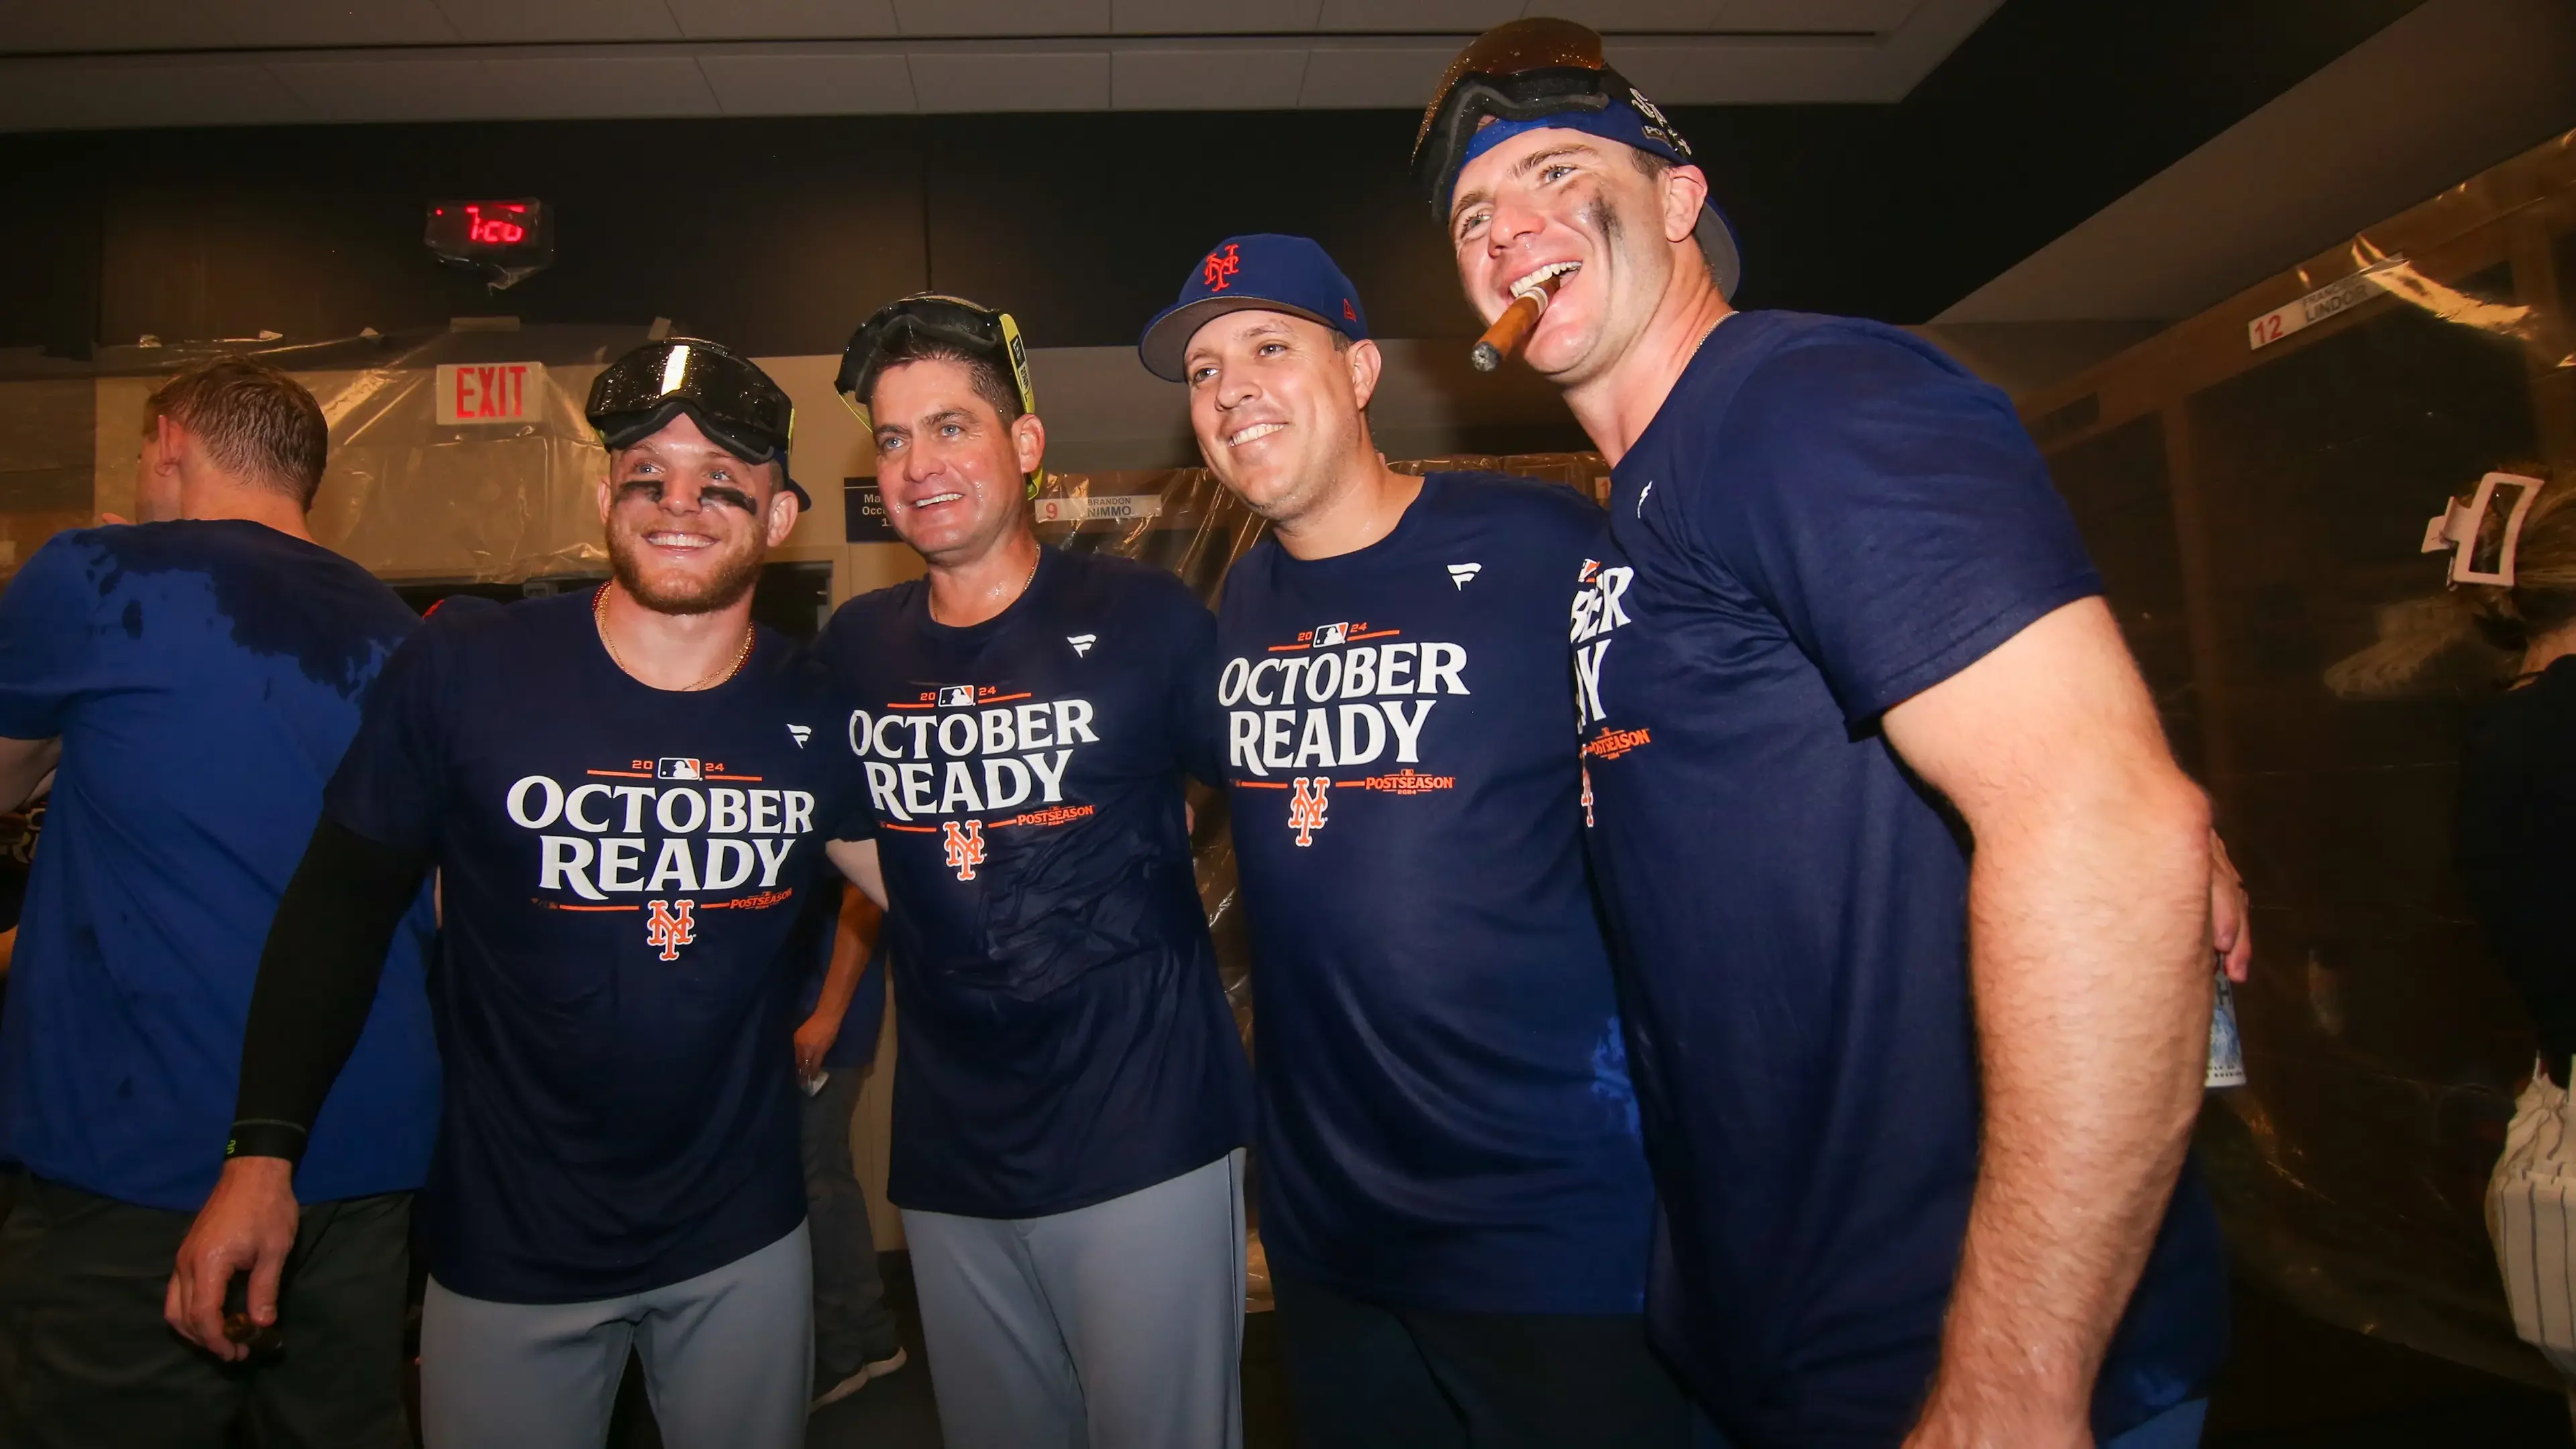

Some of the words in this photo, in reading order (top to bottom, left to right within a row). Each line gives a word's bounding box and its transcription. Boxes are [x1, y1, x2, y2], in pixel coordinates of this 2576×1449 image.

[2305, 284, 2369, 322] LINDOR
[2254, 315, 2283, 344] 12
[456, 366, 527, 419] EXIT
[1045, 503, 1059, 519] 9
[1087, 497, 1131, 506] BRANDON
[1087, 506, 1131, 518] NIMMO
[1298, 631, 1312, 641] 20
[1350, 622, 1368, 633] 24
[1218, 642, 1471, 707] OCTOBER
[920, 692, 936, 702] 20
[979, 686, 997, 696] 24
[849, 699, 1100, 759] OCTOBER
[1230, 700, 1437, 776] READY
[632, 759, 653, 770] 20
[705, 762, 725, 772] 24
[863, 749, 1075, 821] READY
[1366, 776, 1454, 790] POSTSEASON
[506, 775, 816, 835] OCTOBER
[1017, 805, 1094, 826] POSTSEASON
[539, 835, 797, 900] READY
[730, 888, 793, 909] POSTSEASON
